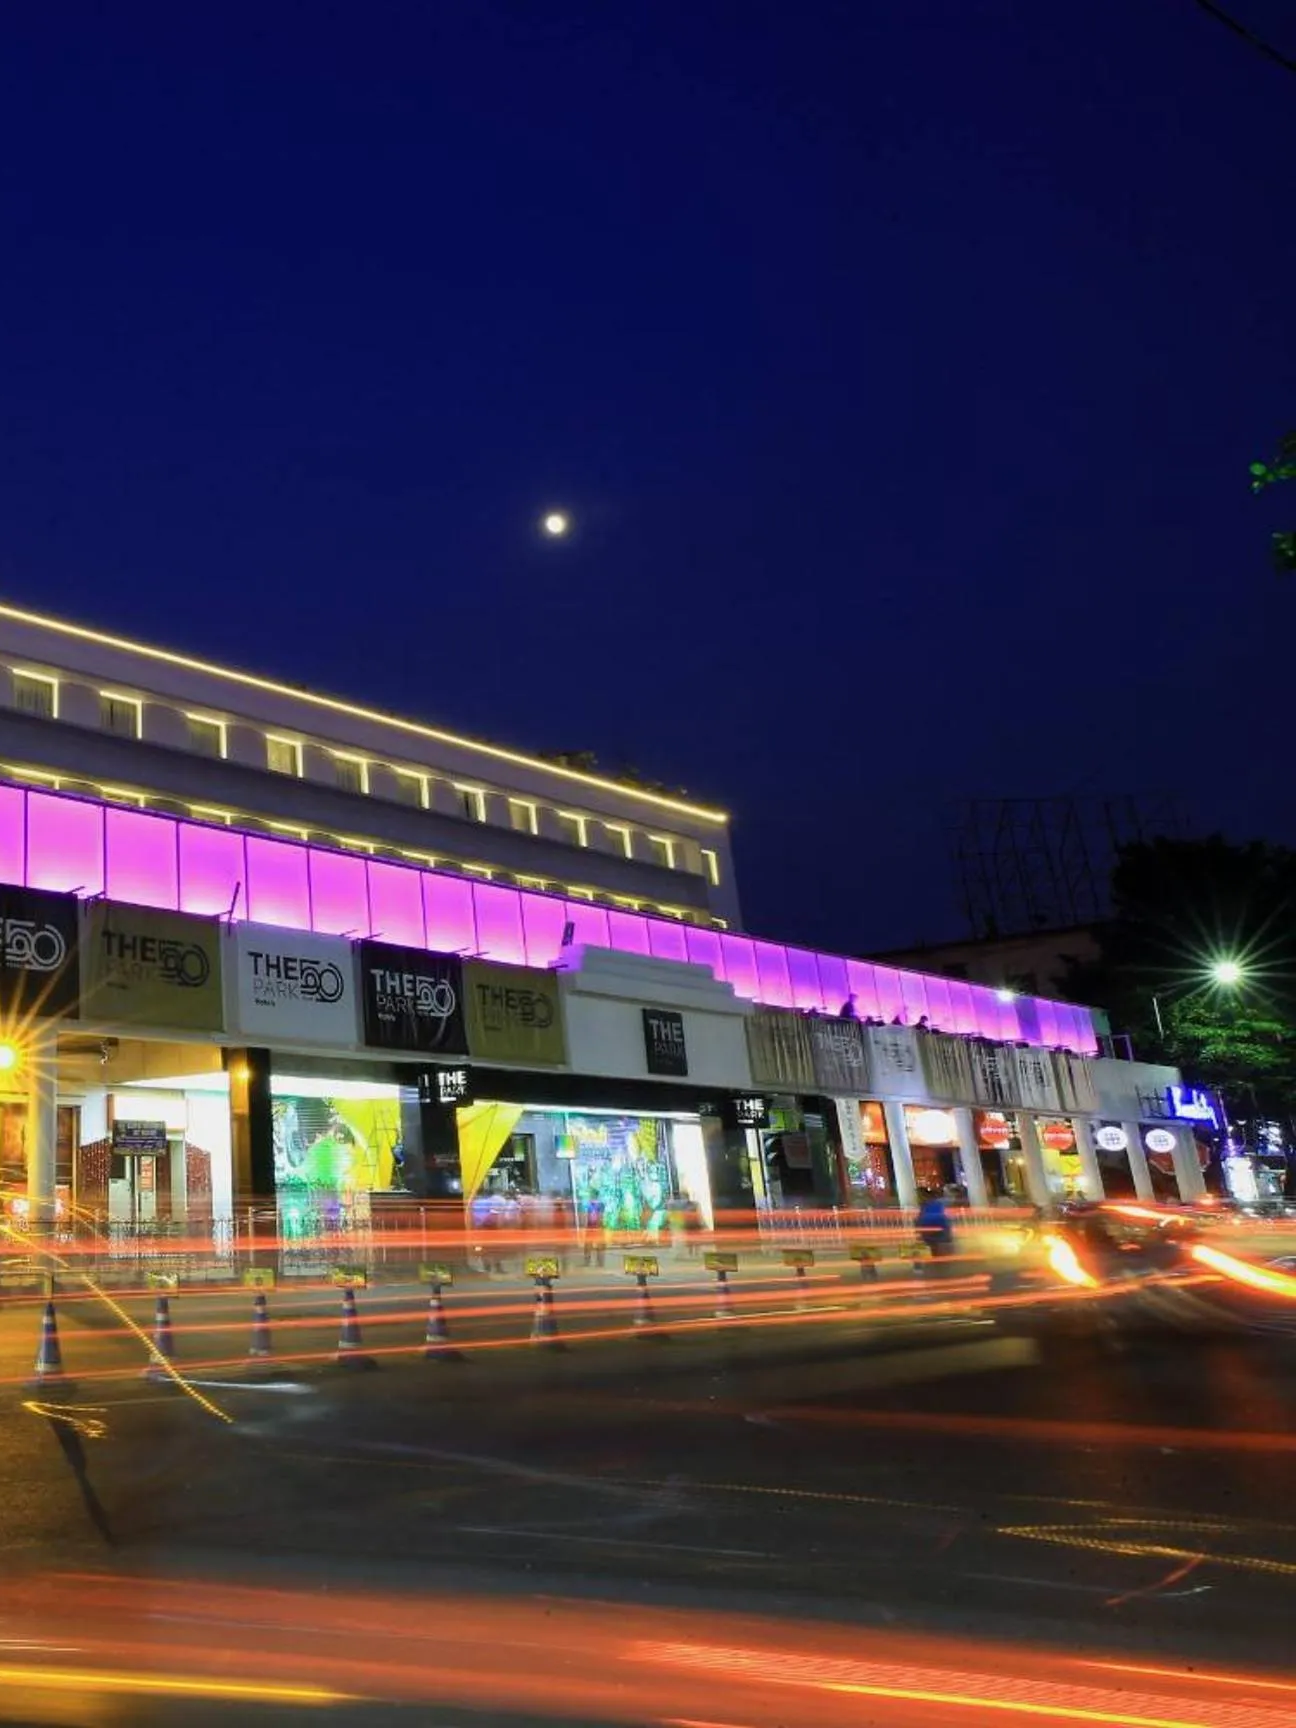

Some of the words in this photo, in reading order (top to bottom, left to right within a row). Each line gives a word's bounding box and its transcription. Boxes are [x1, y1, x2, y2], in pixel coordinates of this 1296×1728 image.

[101, 928, 157, 962] THE
[247, 951, 299, 980] THE
[253, 978, 299, 999] PARK
[370, 968, 414, 996] THE
[648, 1018, 683, 1042] THE
[438, 1071, 467, 1086] THE
[733, 1098, 765, 1110] THE
